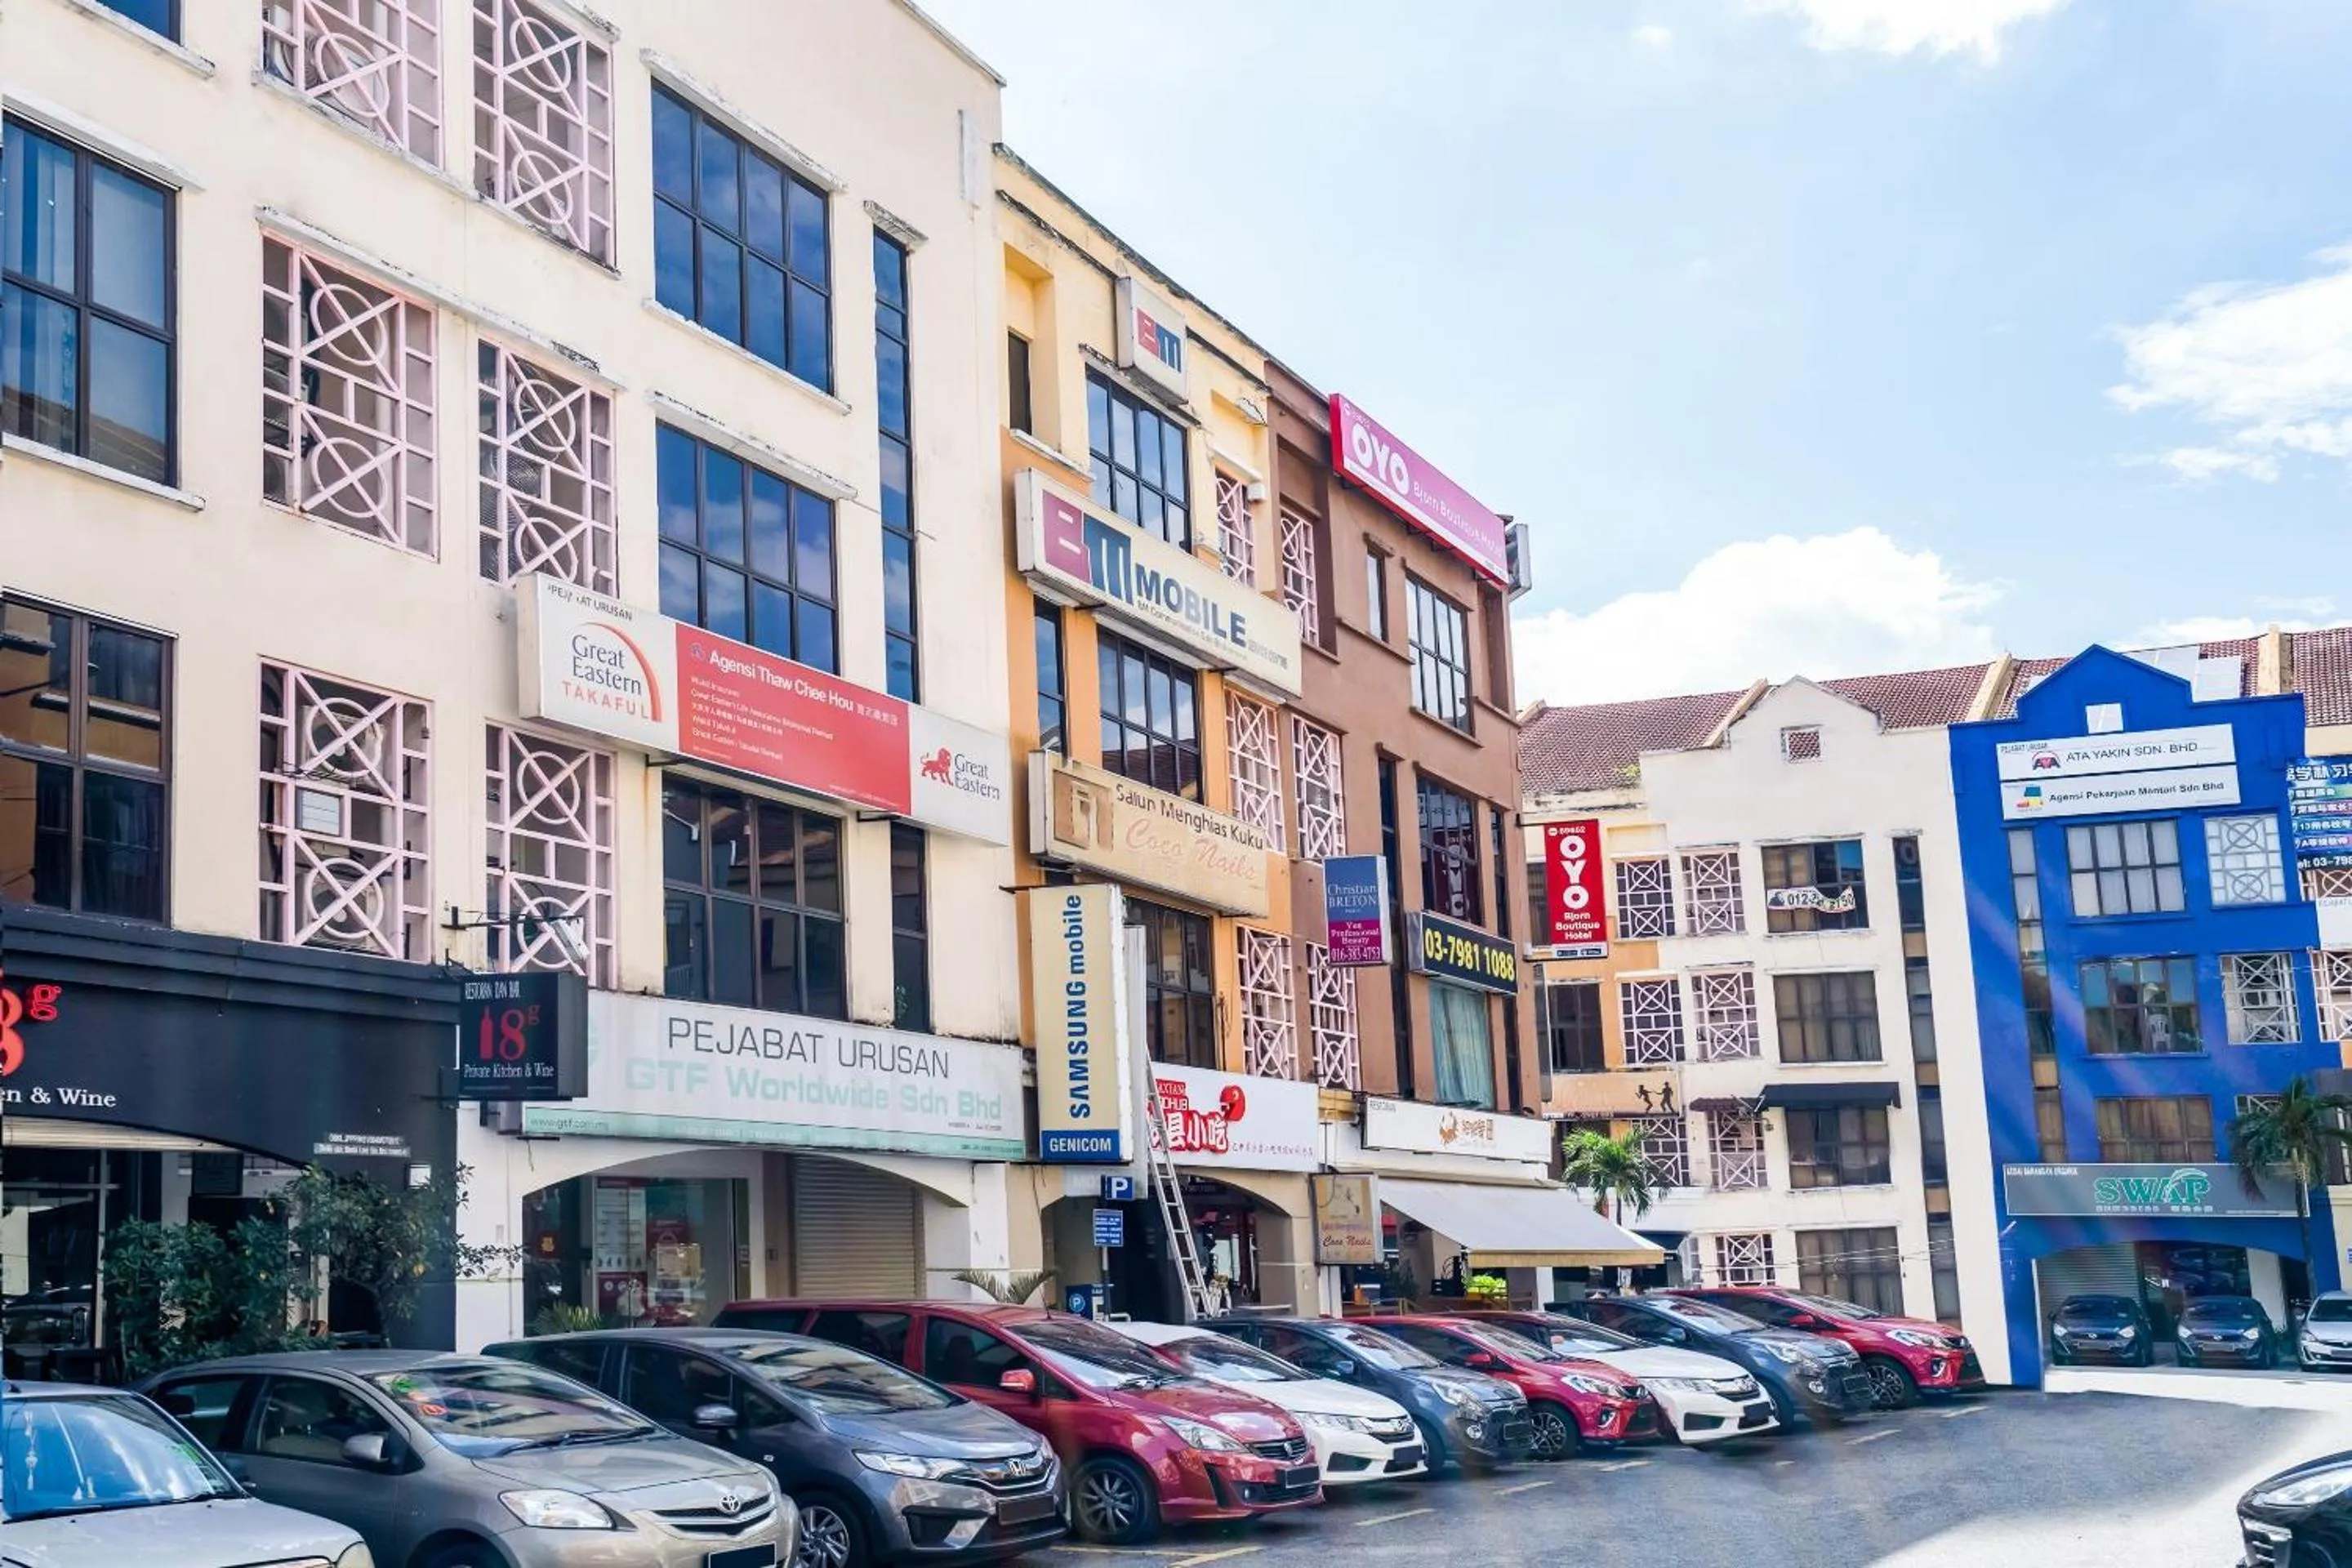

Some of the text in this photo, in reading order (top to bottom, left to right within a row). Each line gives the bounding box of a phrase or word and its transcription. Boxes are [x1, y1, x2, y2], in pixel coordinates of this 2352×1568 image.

[1352, 422, 1410, 496] OYO
[594, 599, 633, 621] URUSAN
[1134, 564, 1246, 648] MOBILE
[572, 634, 626, 669] Great
[572, 656, 642, 696] Eastern
[710, 650, 854, 711] Agensi Thaw Chee Hou
[562, 680, 649, 719] TAKAFUL
[2066, 752, 2091, 762] ATA
[2092, 748, 2131, 760] YAKIN
[2169, 742, 2198, 753] BHD
[954, 754, 988, 780] Great
[955, 771, 1000, 800] Eastern
[2203, 782, 2224, 791] Bhd
[1116, 782, 1264, 850] Salun Menghias Kuku
[1125, 818, 1184, 858] Coco
[1560, 835, 1589, 909] OYO
[1328, 884, 1377, 896] Christian
[1329, 894, 1377, 908] BRETON
[1555, 921, 1600, 931] Boutique
[1563, 912, 1590, 922] Bjorn
[1063, 894, 1085, 974] mobile
[1565, 931, 1592, 940] Hotel
[1424, 928, 1515, 981] 03-7981 1088
[669, 1018, 950, 1079] PEJABAT URUSAN
[1066, 981, 1090, 1118] SAMSUNG
[464, 1062, 555, 1078] Private Kitchen & Wine
[30, 1086, 51, 1104] &
[57, 1087, 117, 1107] Wine
[626, 1056, 1002, 1120] GTF Worldwide Sdn Bhd
[1049, 1138, 1111, 1152] GENICOM
[1111, 1178, 1129, 1199] P
[2094, 1176, 2212, 1204] SWAP
